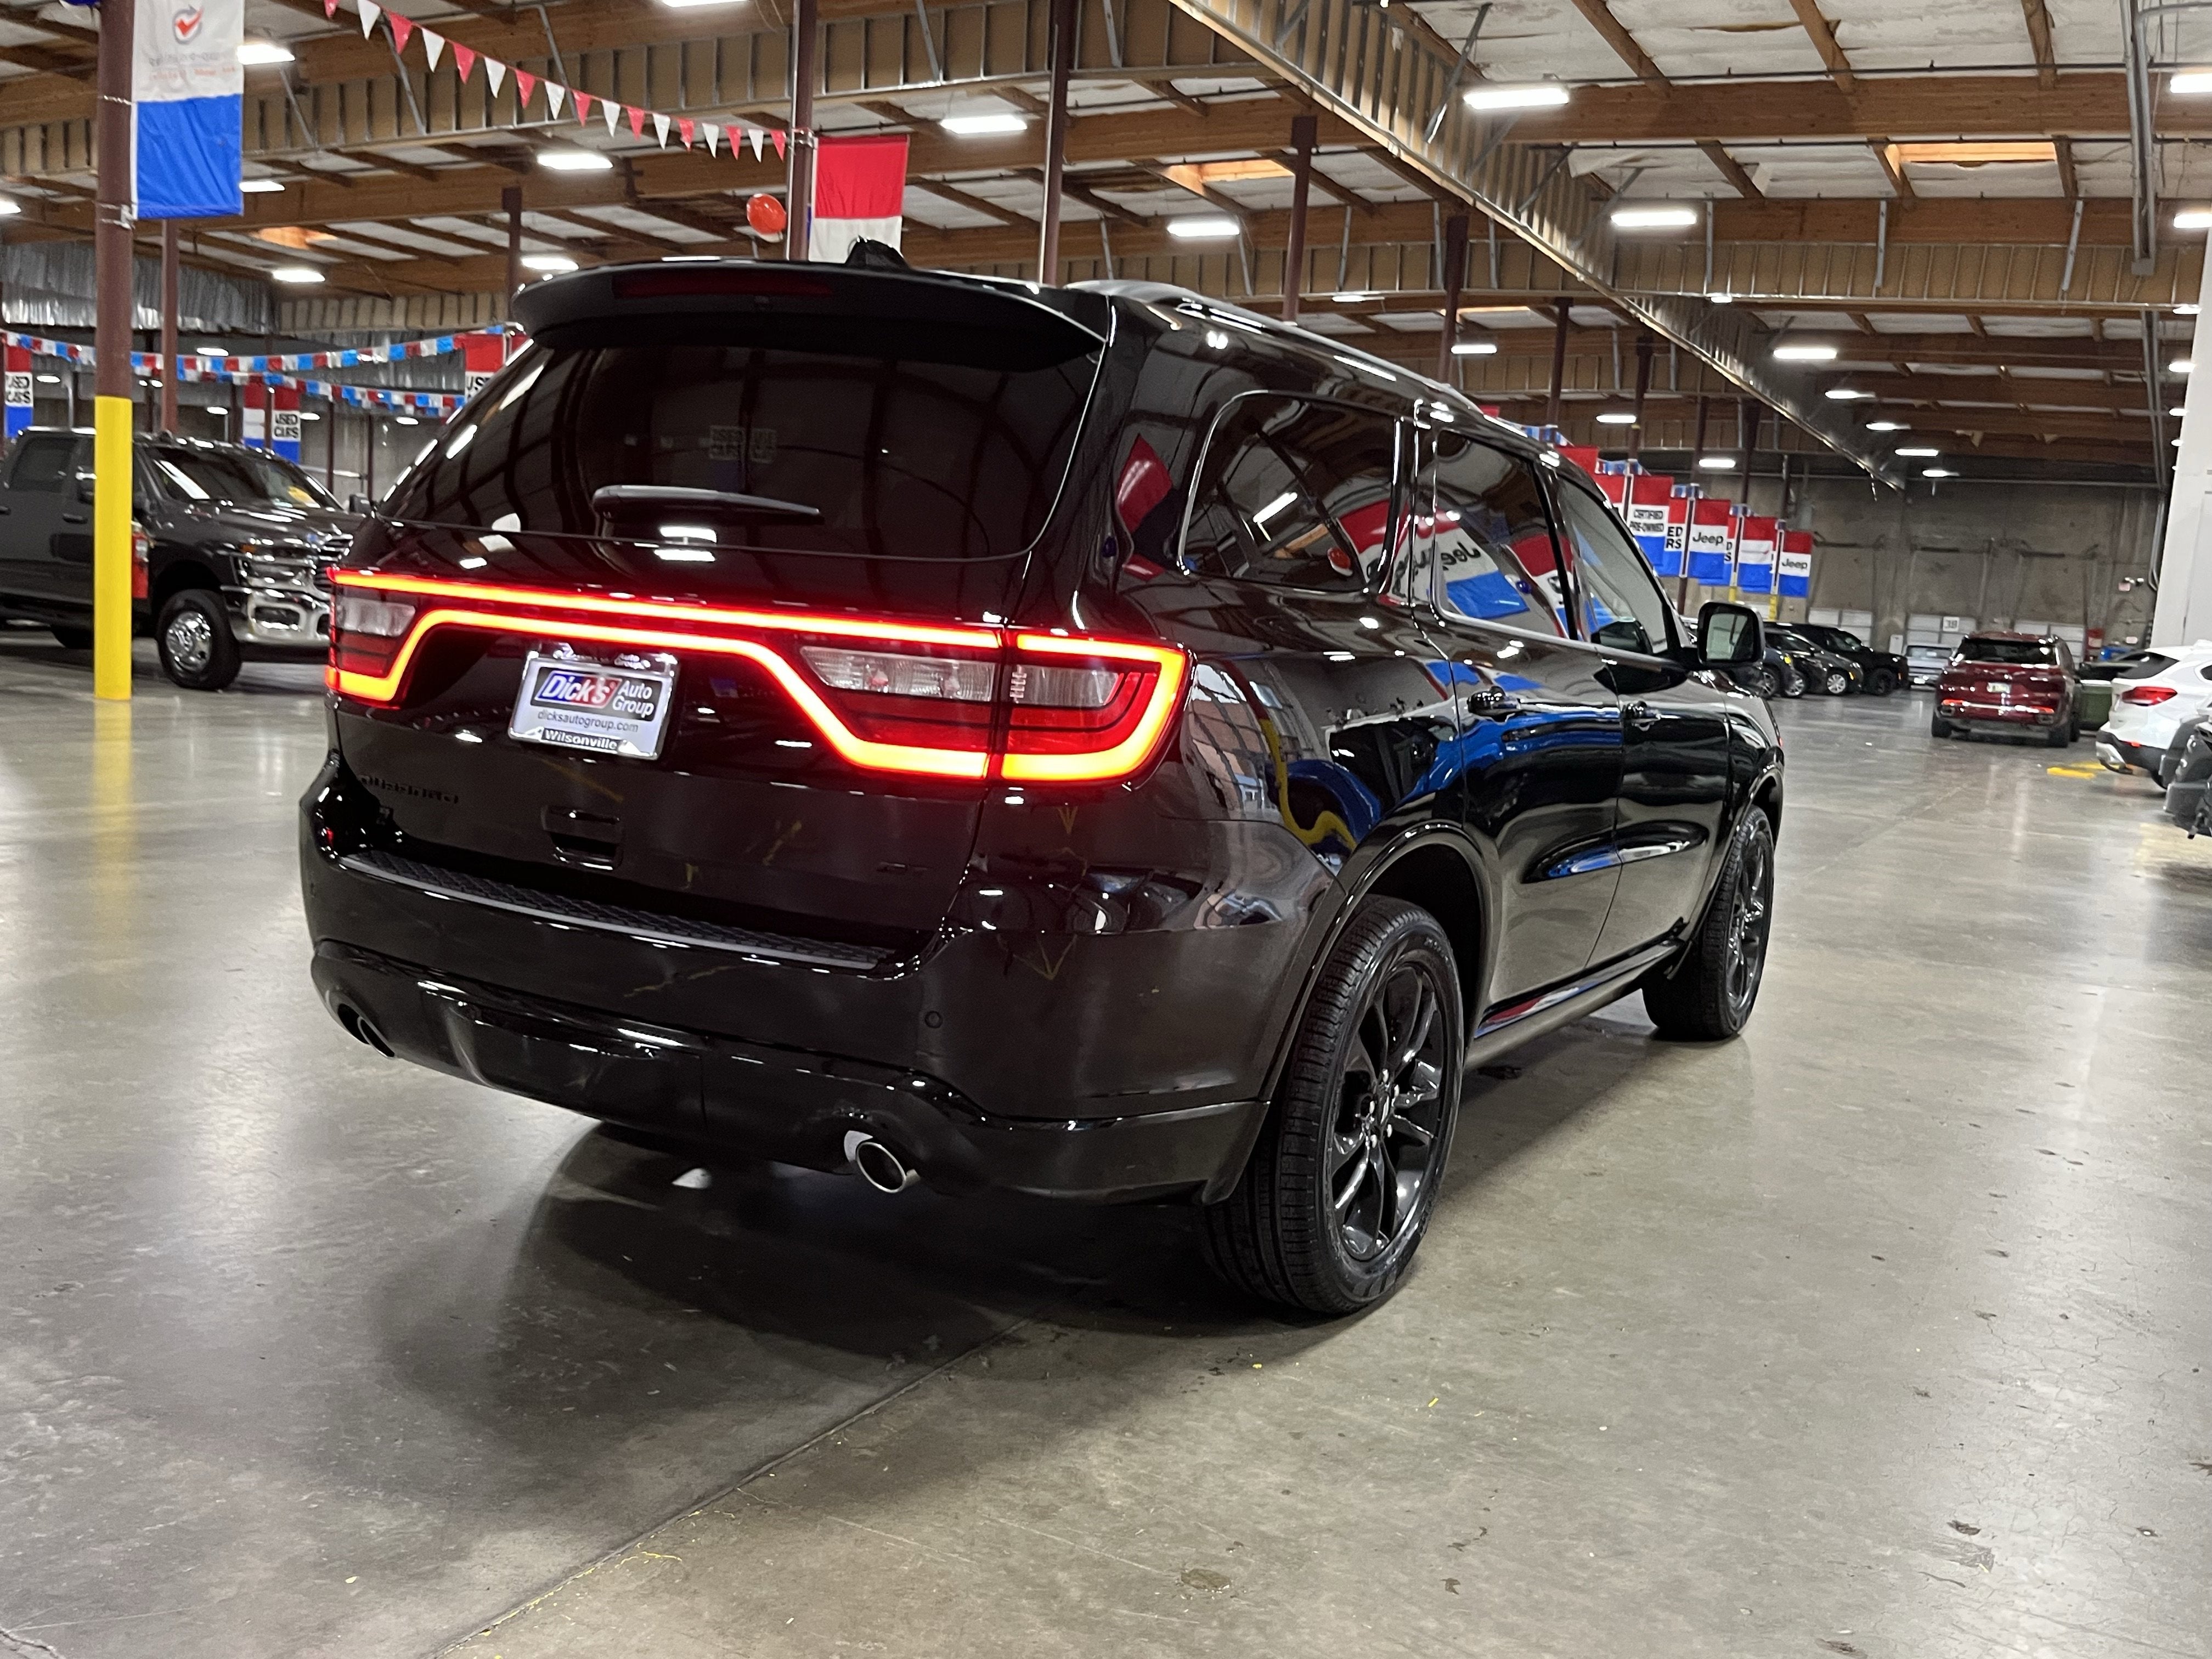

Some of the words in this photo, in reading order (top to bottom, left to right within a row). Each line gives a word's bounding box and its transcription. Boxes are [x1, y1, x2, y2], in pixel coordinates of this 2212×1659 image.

[1667, 526, 1683, 537] ED
[1692, 532, 1724, 546] Jeep
[1782, 558, 1808, 569] Jeep
[542, 675, 610, 704] Dick's
[617, 680, 653, 699] Auto
[612, 696, 654, 718] Group
[538, 709, 639, 732] dicksautogroup.com
[545, 729, 617, 749] Wilsonville
